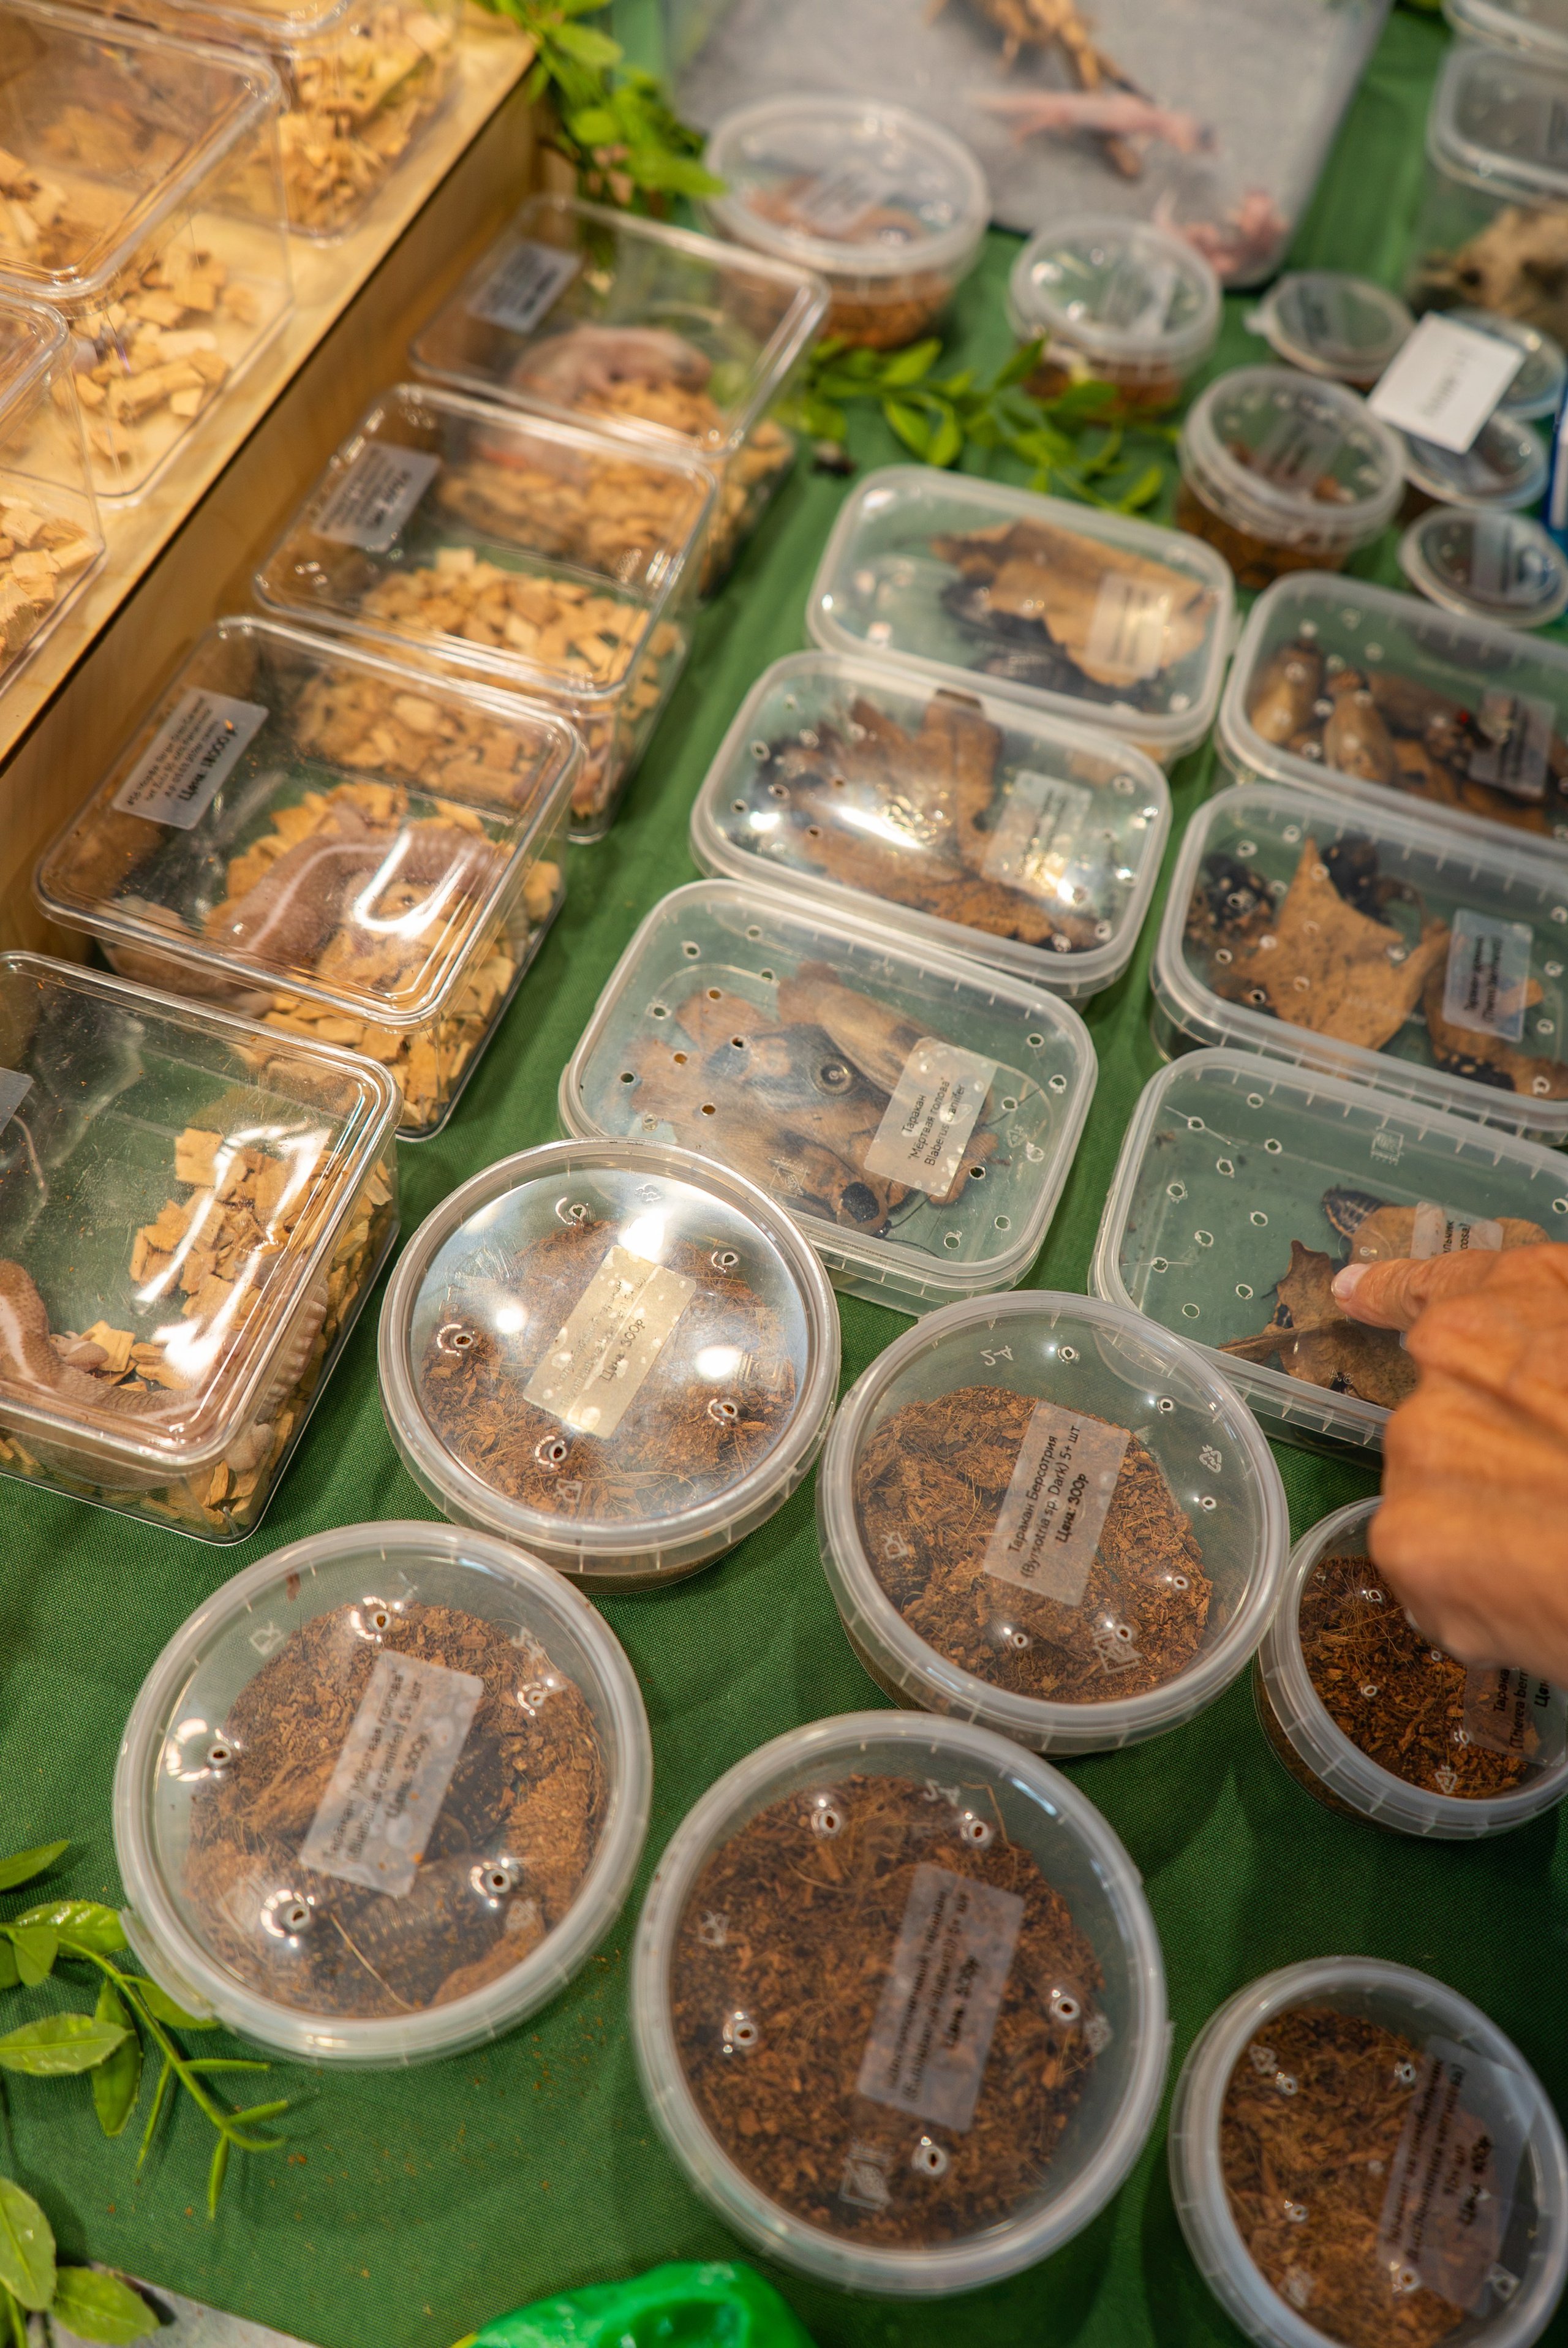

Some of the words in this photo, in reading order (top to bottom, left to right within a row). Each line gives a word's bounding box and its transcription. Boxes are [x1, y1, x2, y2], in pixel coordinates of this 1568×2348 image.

[902, 1094, 927, 1133] Таракан
[907, 1115, 935, 1160] "Мёртвая
[930, 1077, 950, 1115] голова"
[924, 1123, 949, 1166] Blaberus
[620, 1319, 646, 1348] 300р
[1060, 1444, 1072, 1461] 5+
[1068, 1425, 1080, 1443] шт
[1008, 1502, 1035, 1553] Таракан
[1026, 1435, 1058, 1501] Берсотрия
[1048, 1462, 1069, 1495] Dark)
[1045, 1500, 1059, 1516] sp.
[1055, 1507, 1076, 1543] Цена:
[1068, 1473, 1090, 1505] 300р
[1020, 1517, 1050, 1577] (Byrsotria
[1493, 1669, 1510, 1712] Тарака
[1534, 1679, 1551, 1708] Цен
[1509, 1701, 1525, 1750] (Therea
